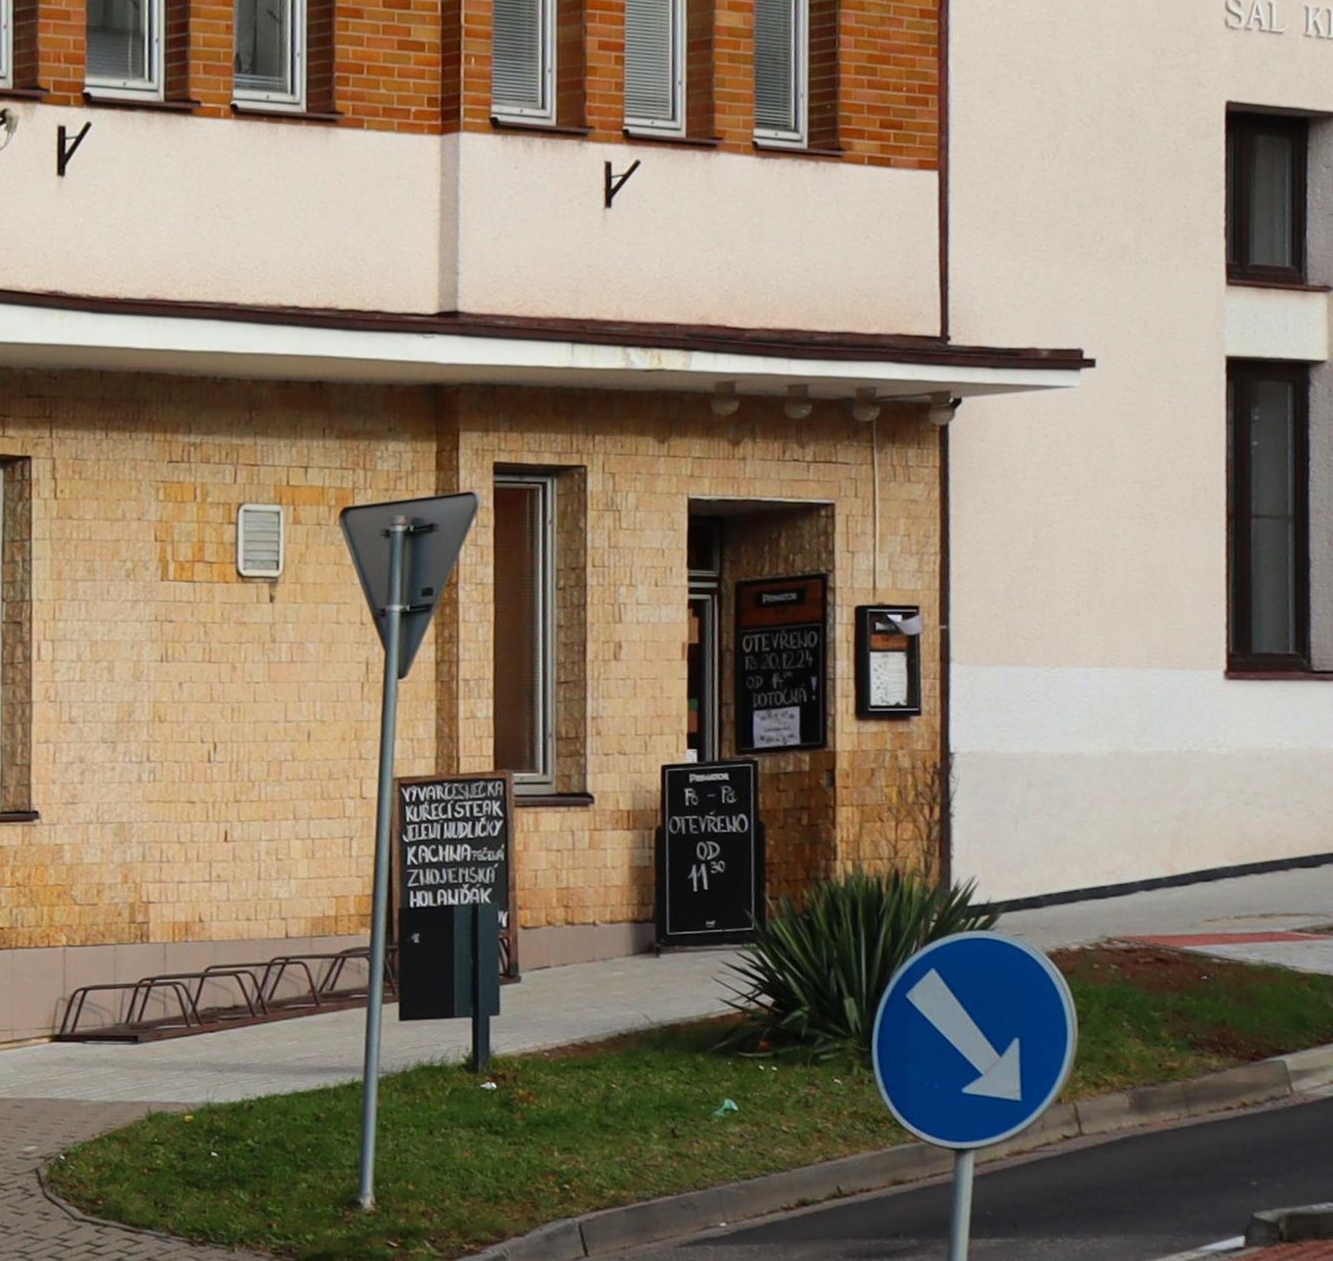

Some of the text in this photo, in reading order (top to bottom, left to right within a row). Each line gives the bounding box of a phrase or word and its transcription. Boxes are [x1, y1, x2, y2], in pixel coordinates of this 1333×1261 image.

[454, 800, 504, 818] STEAK
[668, 811, 749, 834] OTEVŘENO
[406, 844, 471, 865] KACHNA
[696, 841, 720, 860] OD
[406, 863, 498, 887] ZNOJEMSKÁ
[409, 884, 492, 908] HOLANĎÁK
